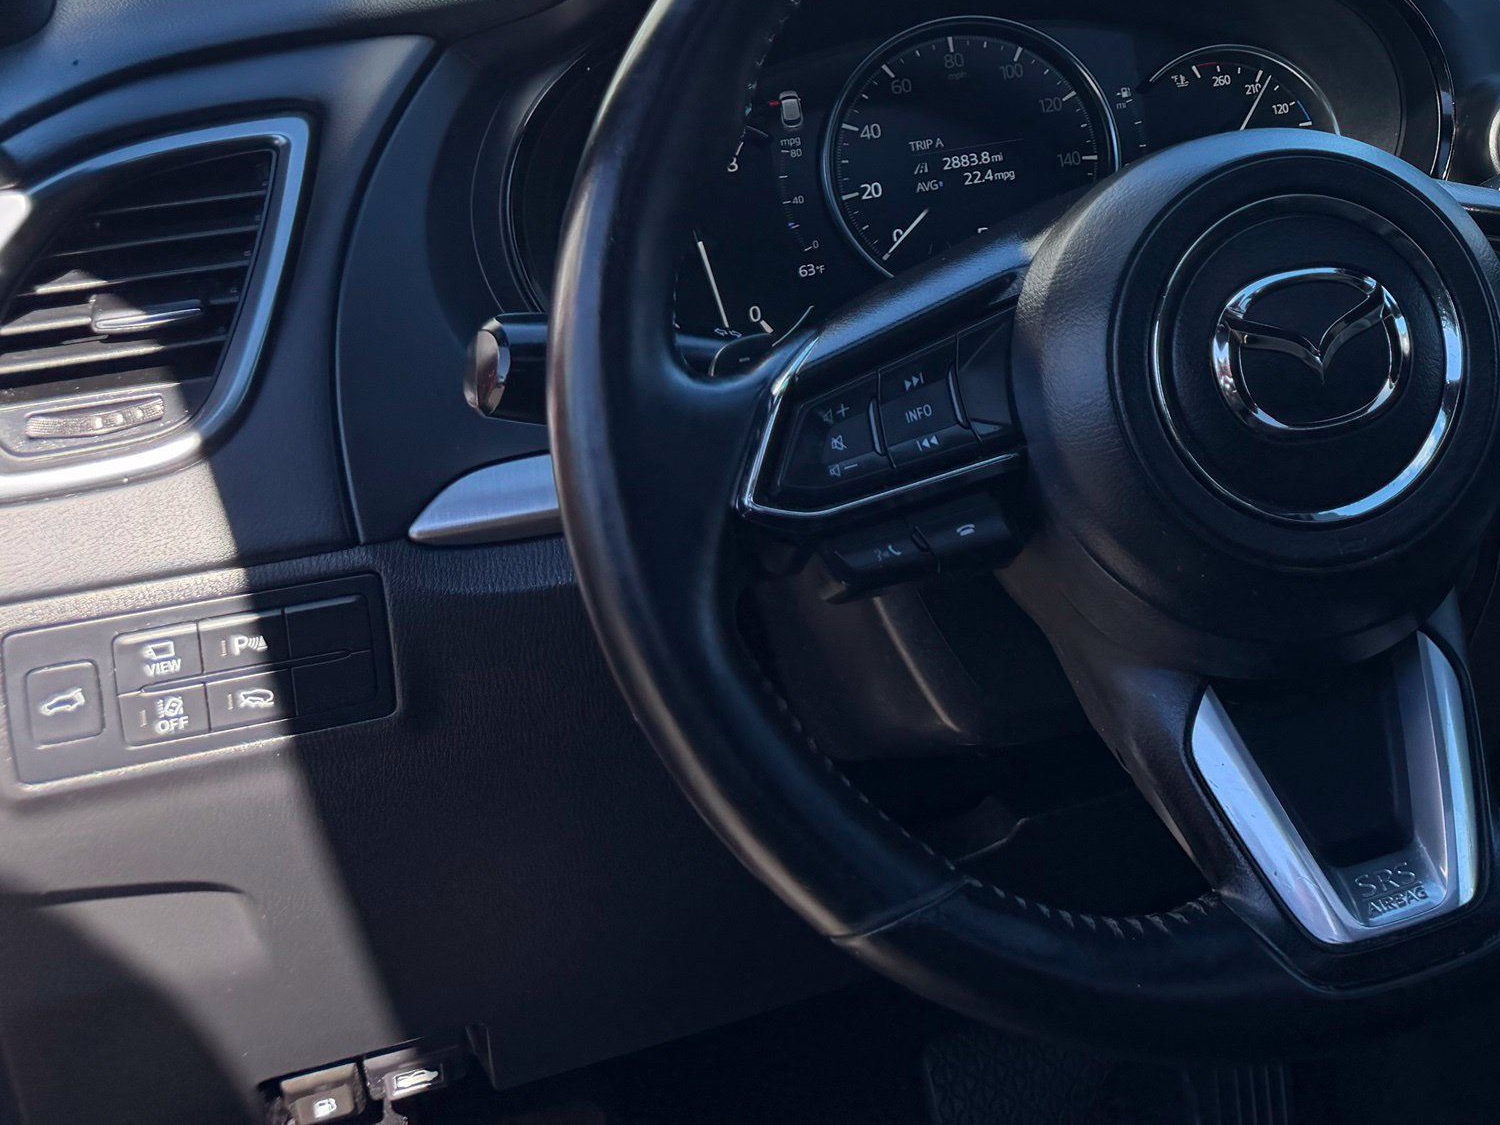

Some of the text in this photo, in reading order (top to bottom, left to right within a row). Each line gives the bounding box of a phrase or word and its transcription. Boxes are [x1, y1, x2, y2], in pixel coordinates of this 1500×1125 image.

[943, 53, 965, 69] 80
[999, 61, 1024, 81] 100
[890, 78, 913, 95] 60
[1211, 74, 1231, 88] 260
[1038, 95, 1063, 114] 120
[1271, 103, 1290, 116] 120
[859, 122, 882, 140] 40
[780, 137, 802, 147] mpg
[908, 136, 945, 154] TRIP A
[790, 147, 803, 159] 80
[1057, 150, 1082, 168] 140
[860, 181, 883, 200] 20
[915, 179, 939, 194] AVG
[791, 194, 805, 205] 40
[749, 304, 762, 323] 0
[905, 403, 933, 425] INFO
[144, 658, 182, 677] VIEW
[155, 715, 189, 734] OFF
[1354, 860, 1418, 898] SRS
[1365, 885, 1429, 917] AIRBAG
